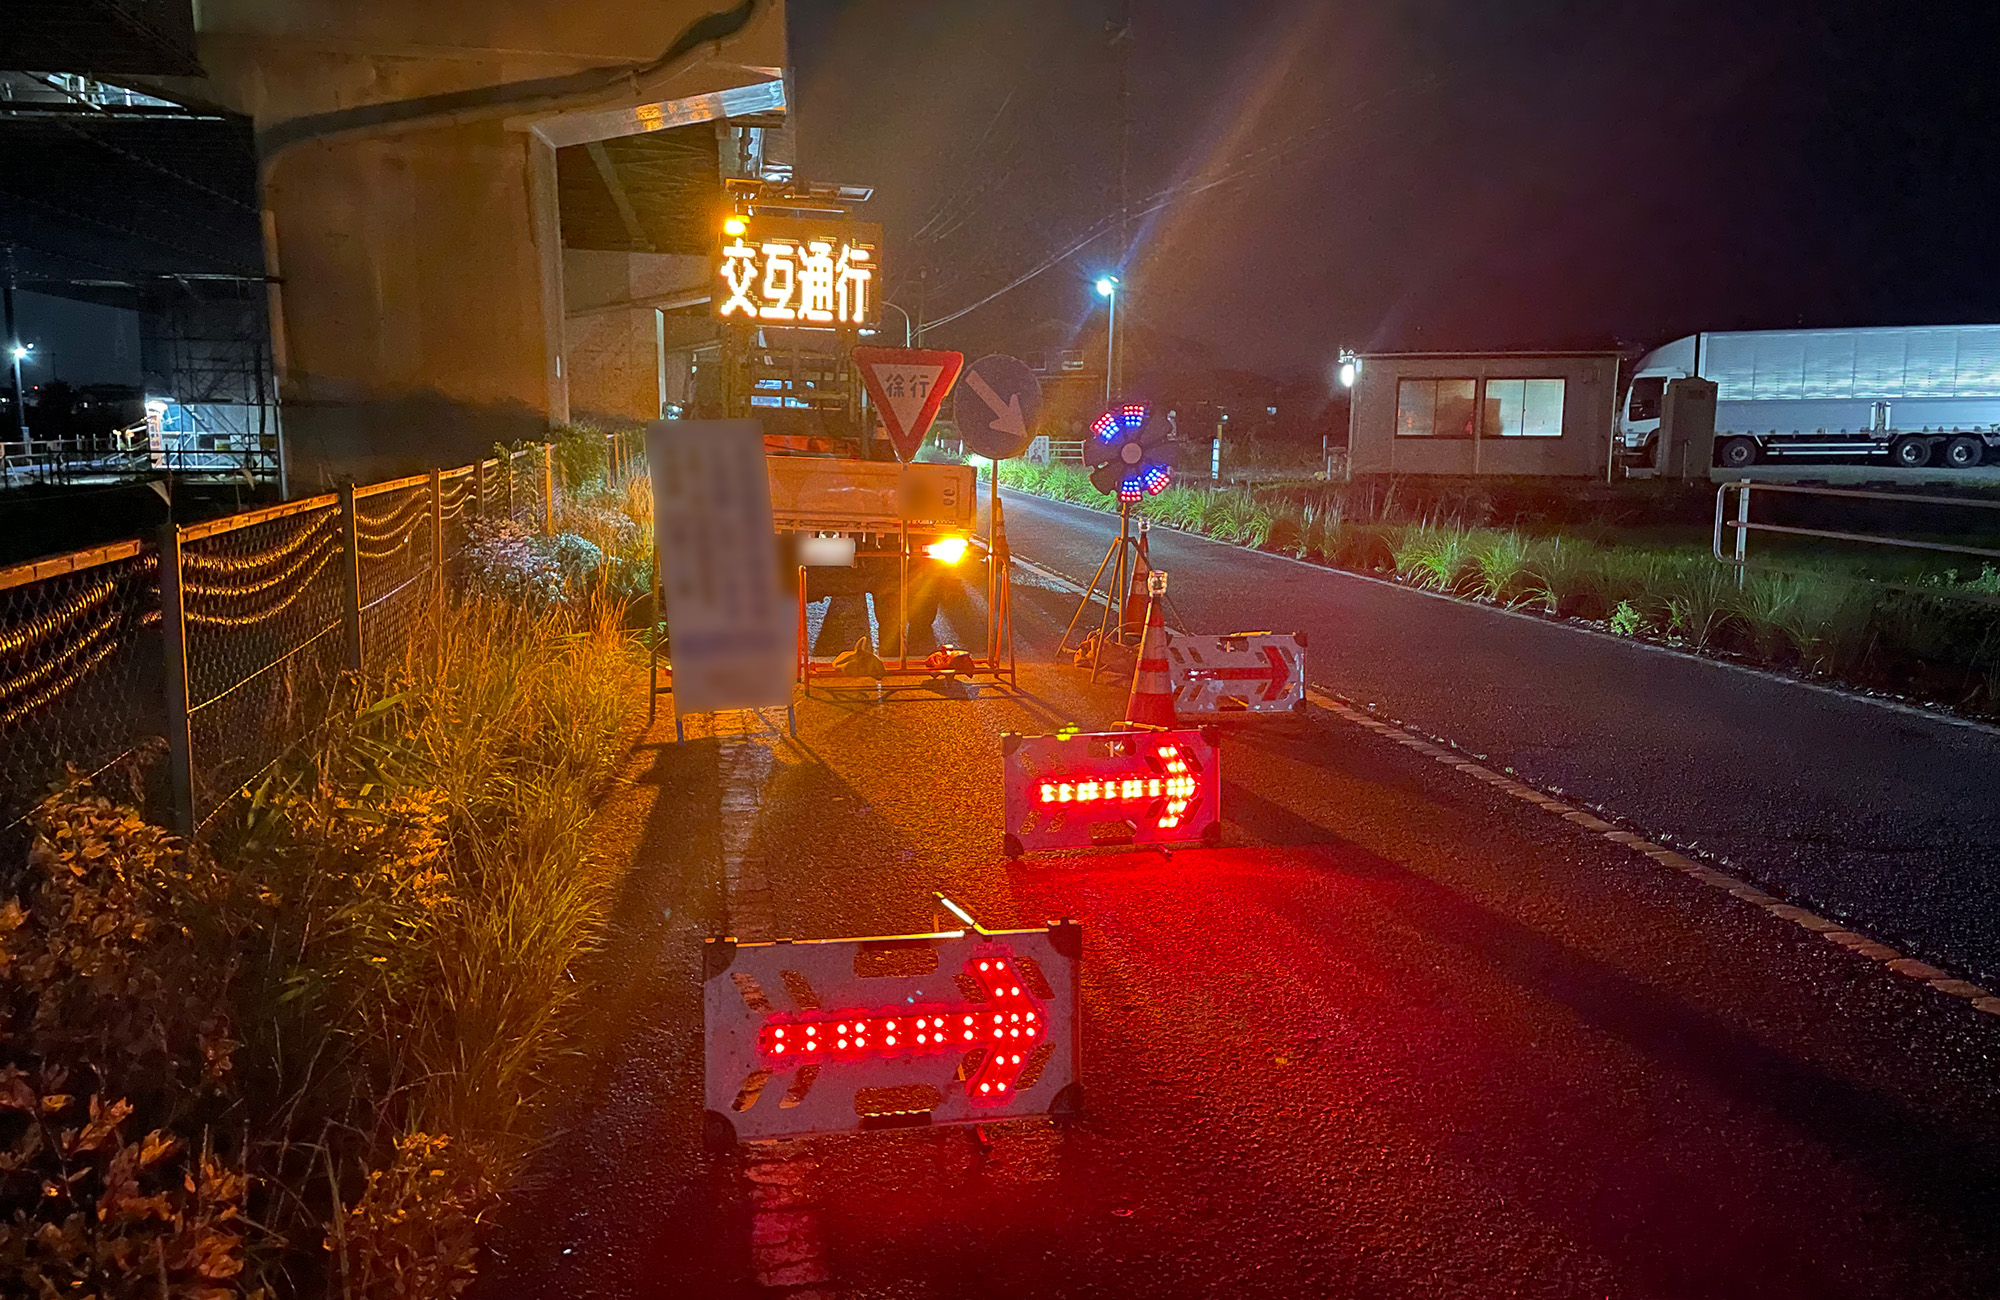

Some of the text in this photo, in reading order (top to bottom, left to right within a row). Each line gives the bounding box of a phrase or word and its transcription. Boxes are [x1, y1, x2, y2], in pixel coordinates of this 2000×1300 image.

[720, 237, 872, 323] 交互通行
[886, 373, 929, 398] 徐行
